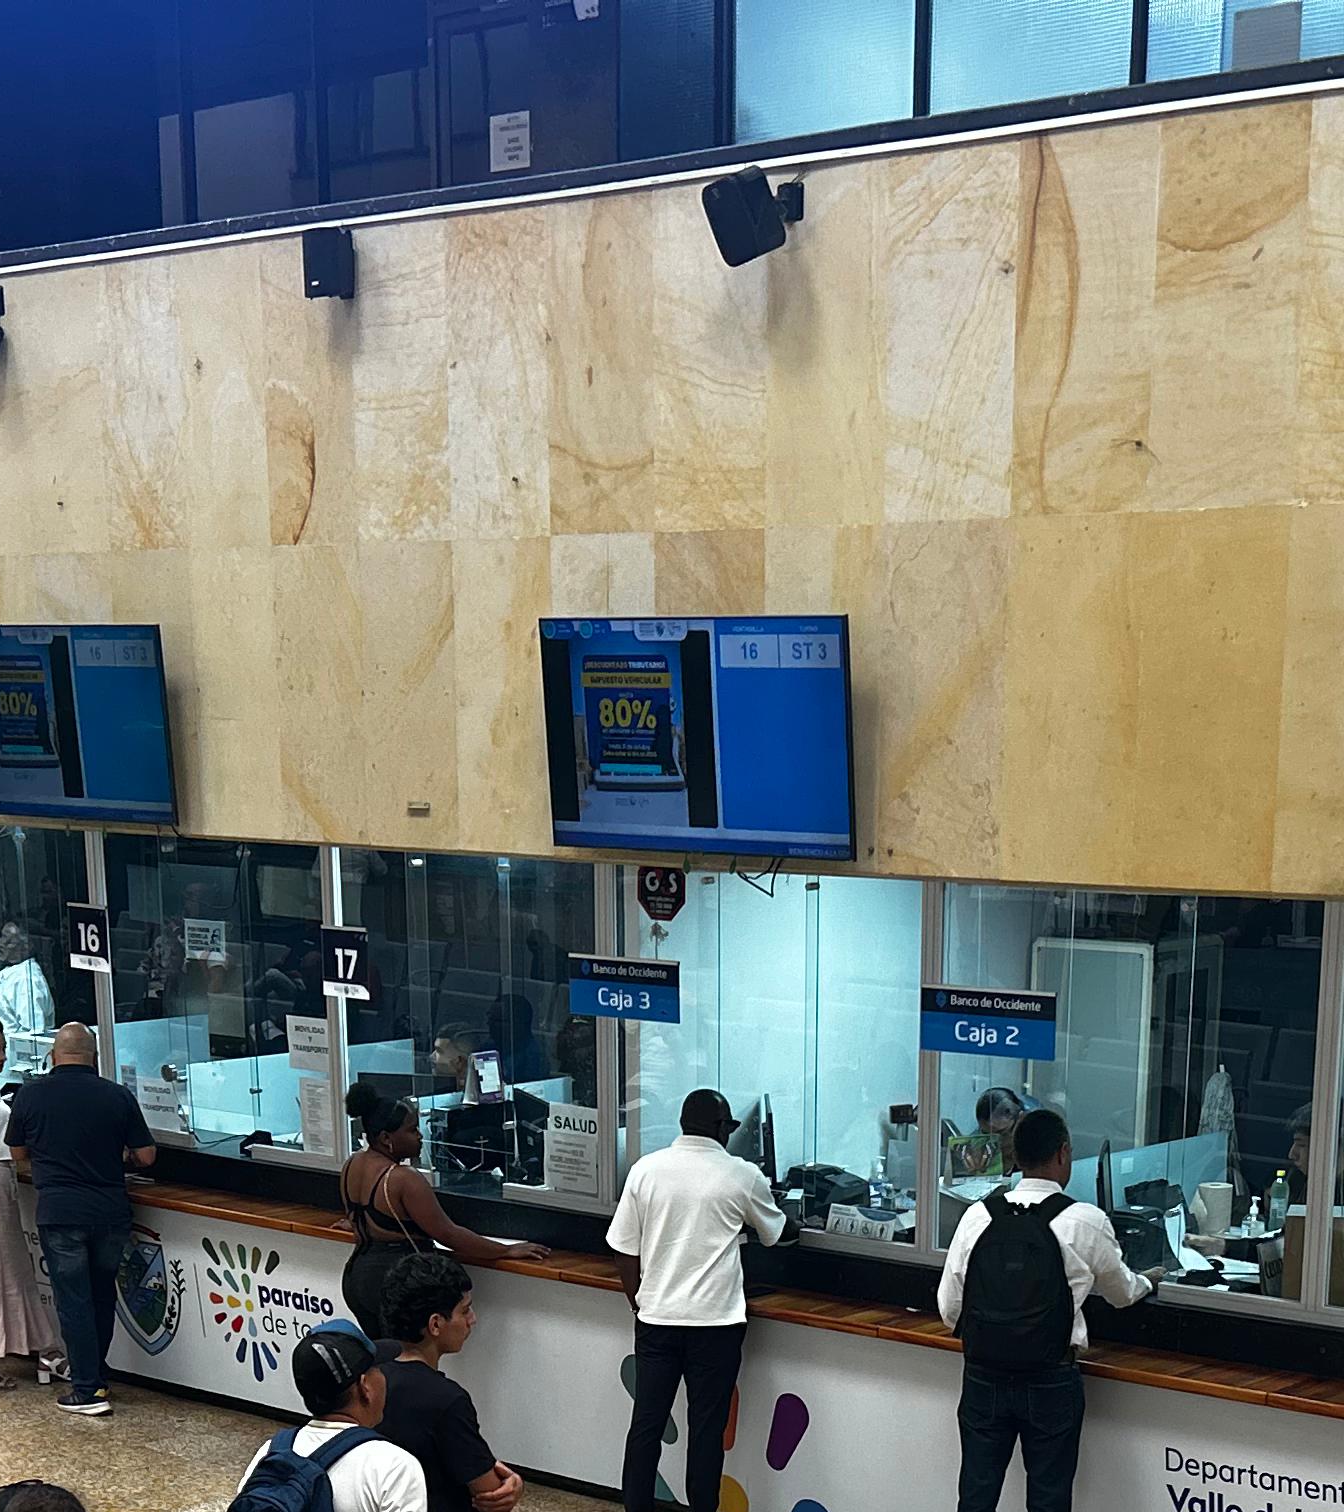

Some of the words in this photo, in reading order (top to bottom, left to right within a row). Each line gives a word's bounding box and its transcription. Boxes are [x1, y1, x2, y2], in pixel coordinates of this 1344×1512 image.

[740, 642, 758, 660] 16
[791, 642, 813, 660] ST
[818, 642, 827, 660] 3
[599, 697, 657, 729] 80%
[645, 871, 678, 893] GS
[76, 922, 101, 953] 16
[334, 948, 358, 980] 17
[592, 963, 617, 975] Banco
[618, 965, 627, 976] de
[628, 966, 668, 979] Occidente
[597, 987, 633, 1012] Caja
[638, 991, 651, 1009] 3
[950, 994, 979, 1006] Banco
[980, 997, 992, 1008] de
[994, 998, 1042, 1012] Occidente
[954, 1020, 998, 1047] Caja
[1005, 1026, 1020, 1046] 2
[553, 1115, 598, 1135] SALUD
[257, 1285, 334, 1317] paraíso
[262, 1308, 287, 1336] de
